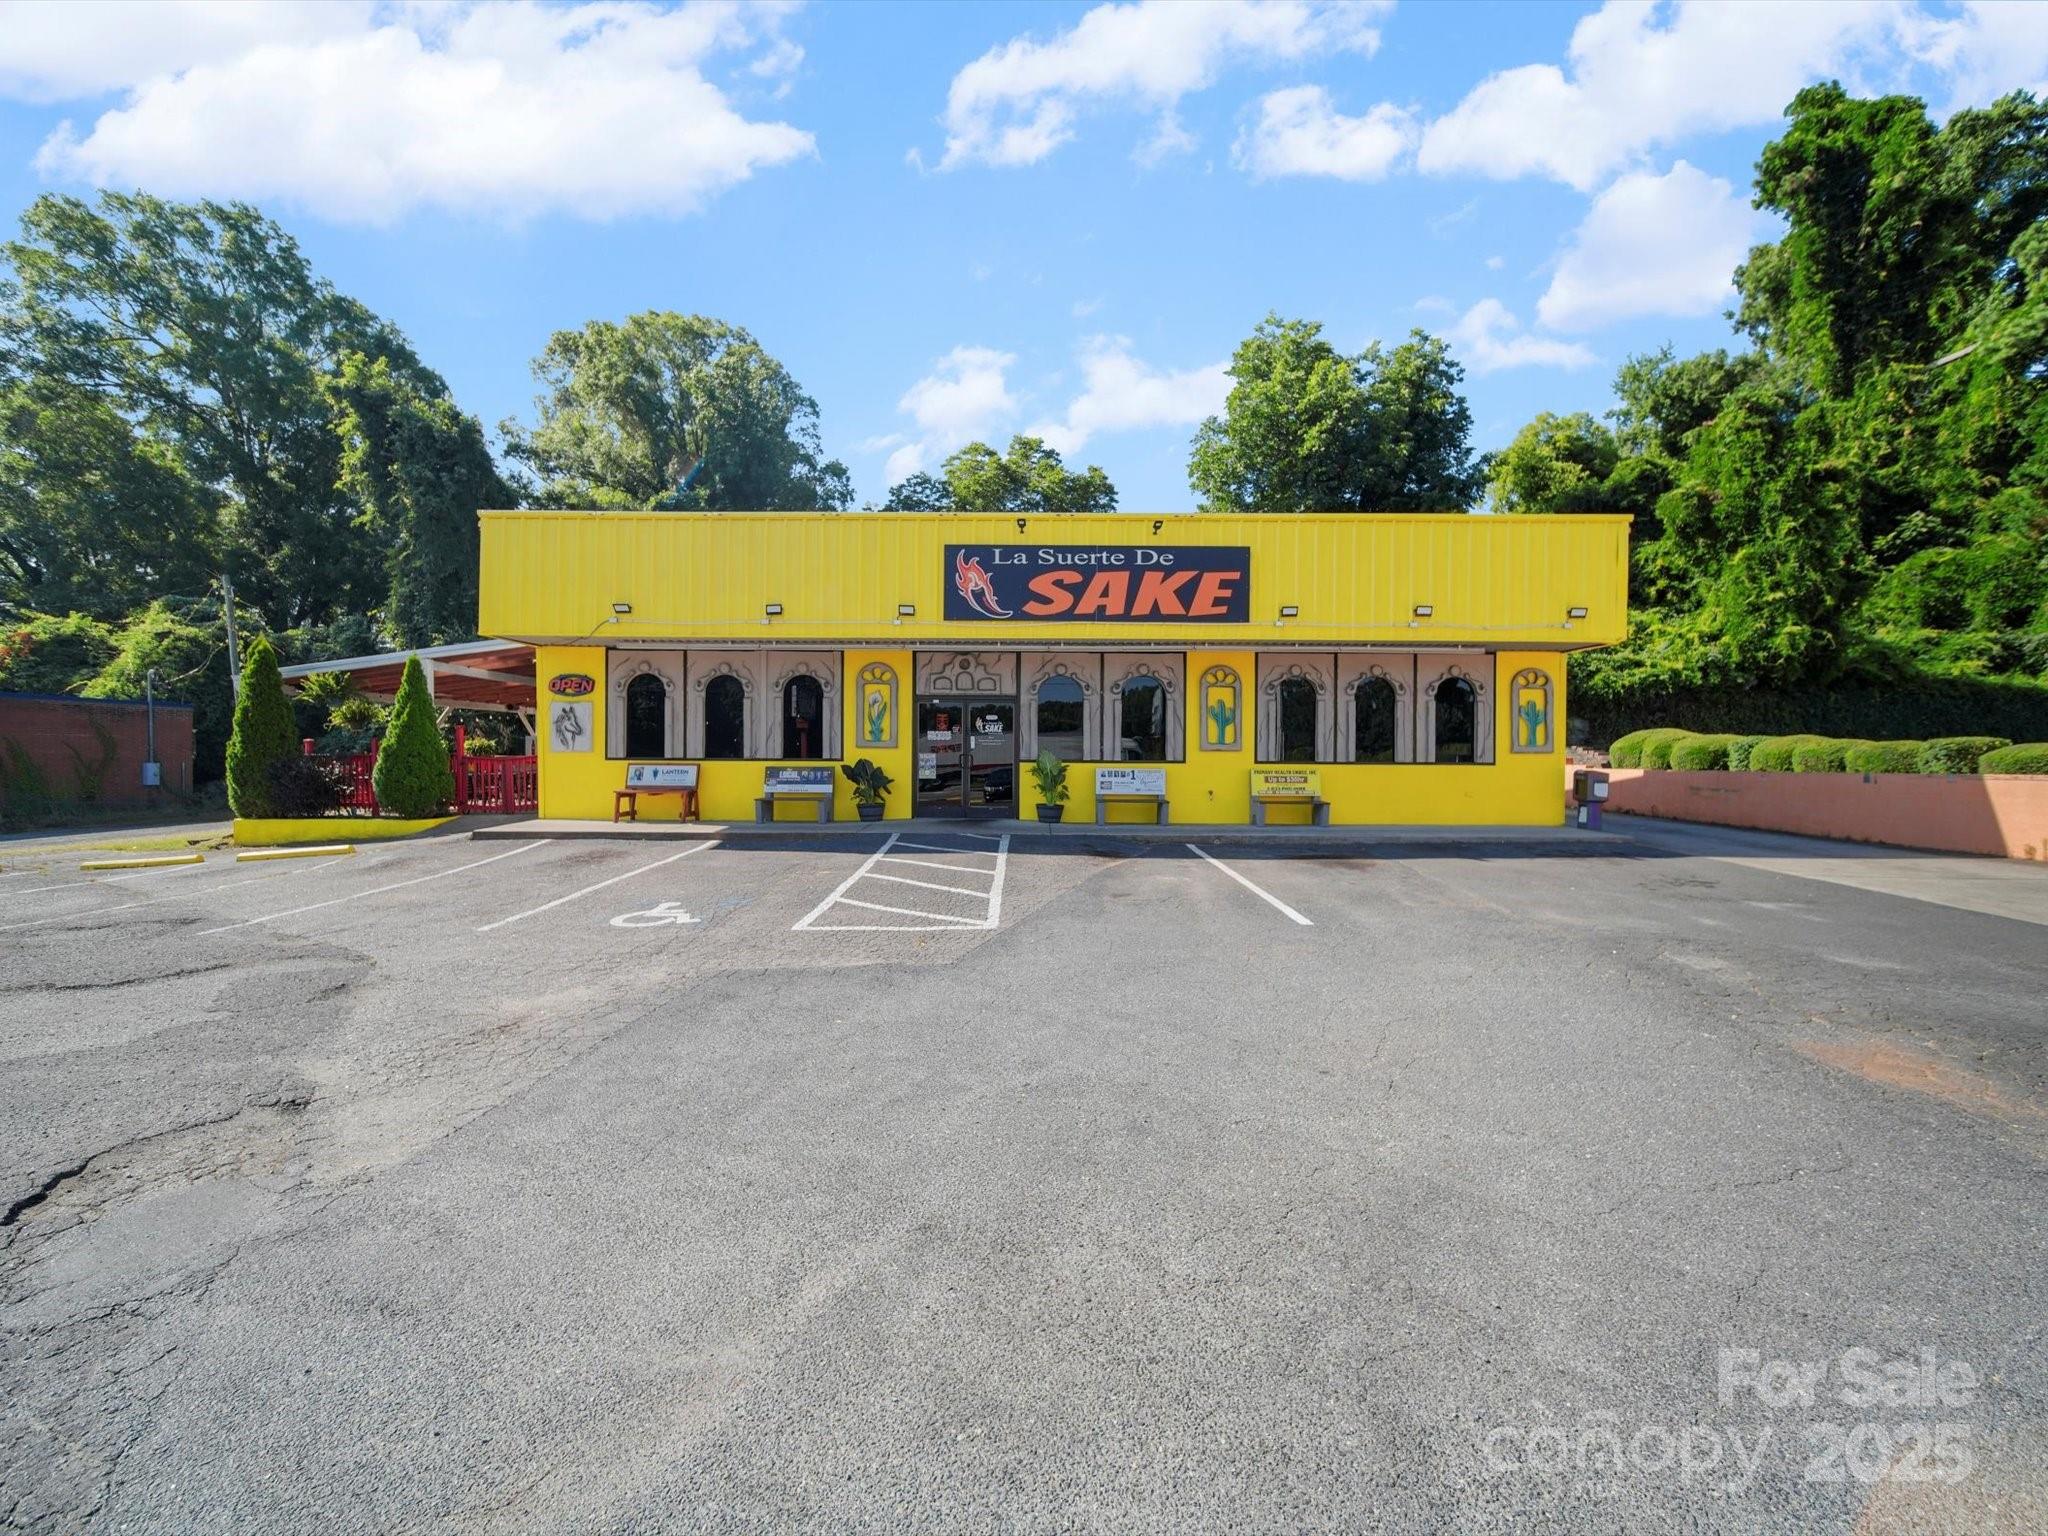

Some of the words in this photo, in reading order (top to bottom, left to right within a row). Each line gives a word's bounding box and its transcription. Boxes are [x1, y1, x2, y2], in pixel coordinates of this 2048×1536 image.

[993, 549, 1028, 565] La
[1038, 549, 1125, 565] Suerte
[1134, 549, 1175, 565] De
[1022, 569, 1241, 617] SAKE
[549, 679, 593, 692] OPEN
[984, 724, 1004, 733] SAKE
[1267, 776, 1278, 784] Up
